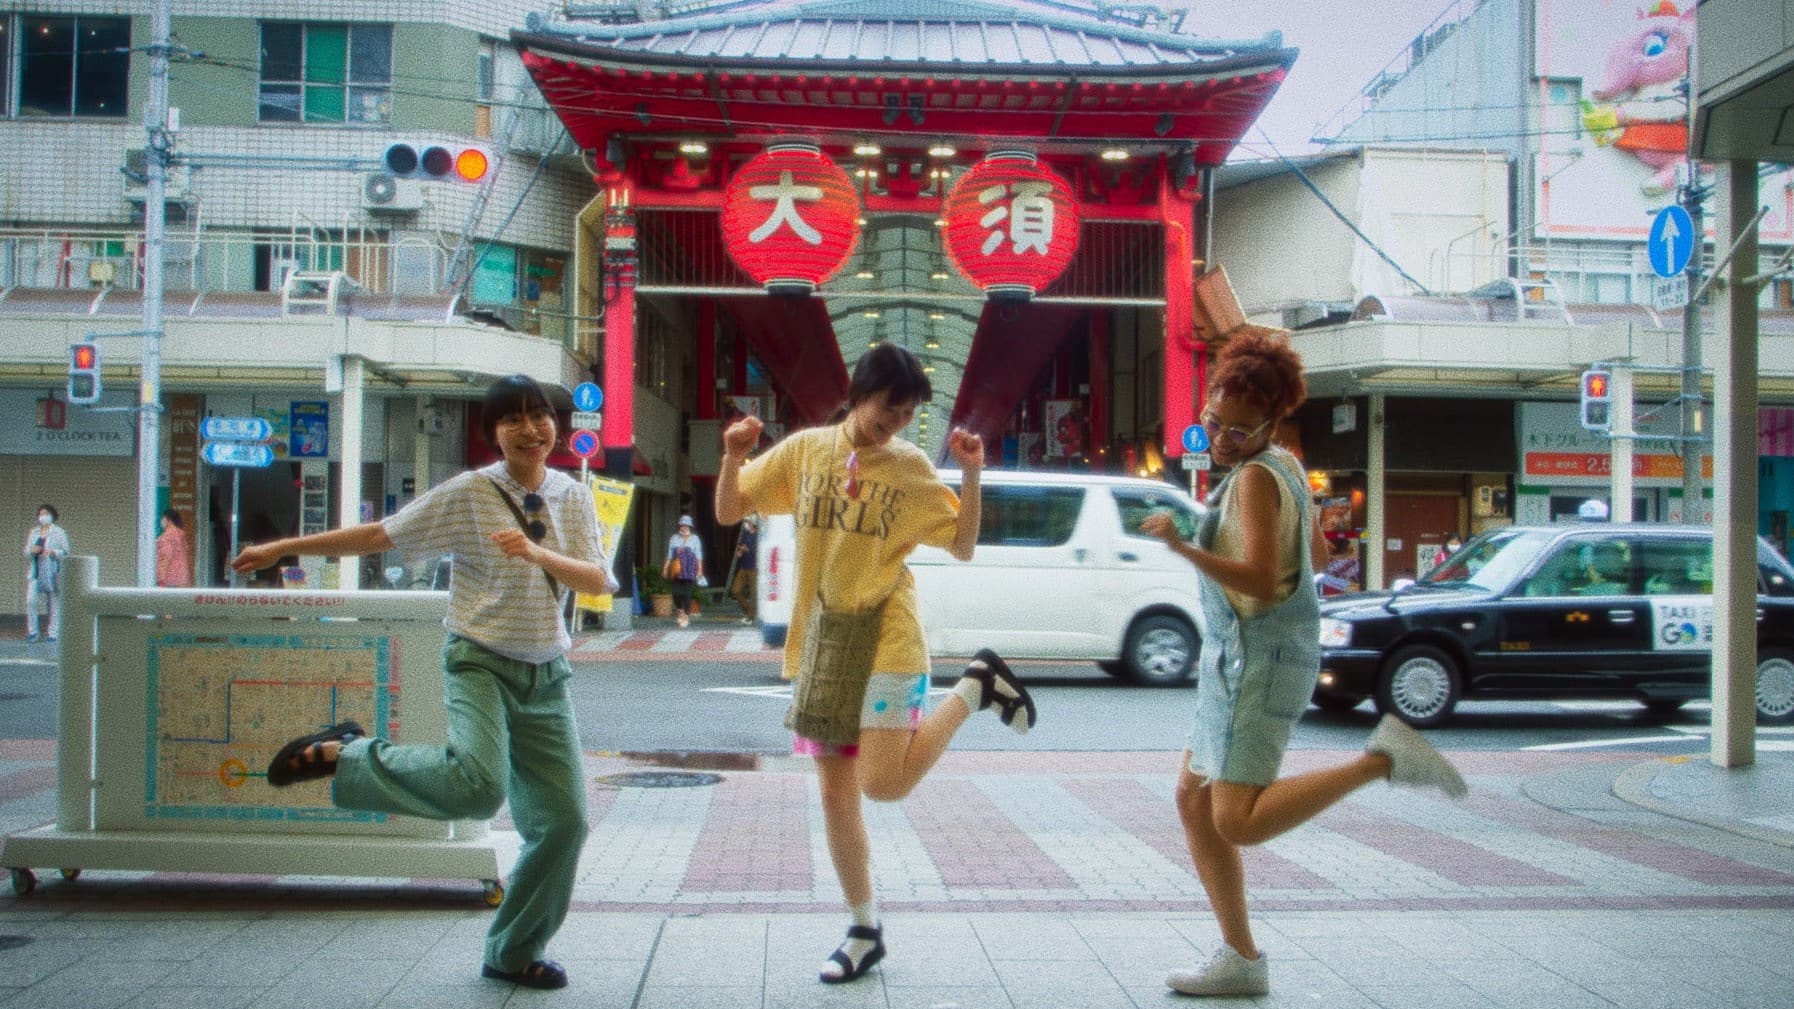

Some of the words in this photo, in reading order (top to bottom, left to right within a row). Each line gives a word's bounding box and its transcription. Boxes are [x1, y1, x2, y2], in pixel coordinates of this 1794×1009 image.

[750, 170, 824, 245] 大
[978, 181, 1054, 255] 須
[98, 431, 121, 441] TEA
[851, 479, 906, 513] THE
[794, 495, 895, 540] GIRLS
[1660, 605, 1697, 619] TAXI
[1661, 622, 1698, 645] GO
